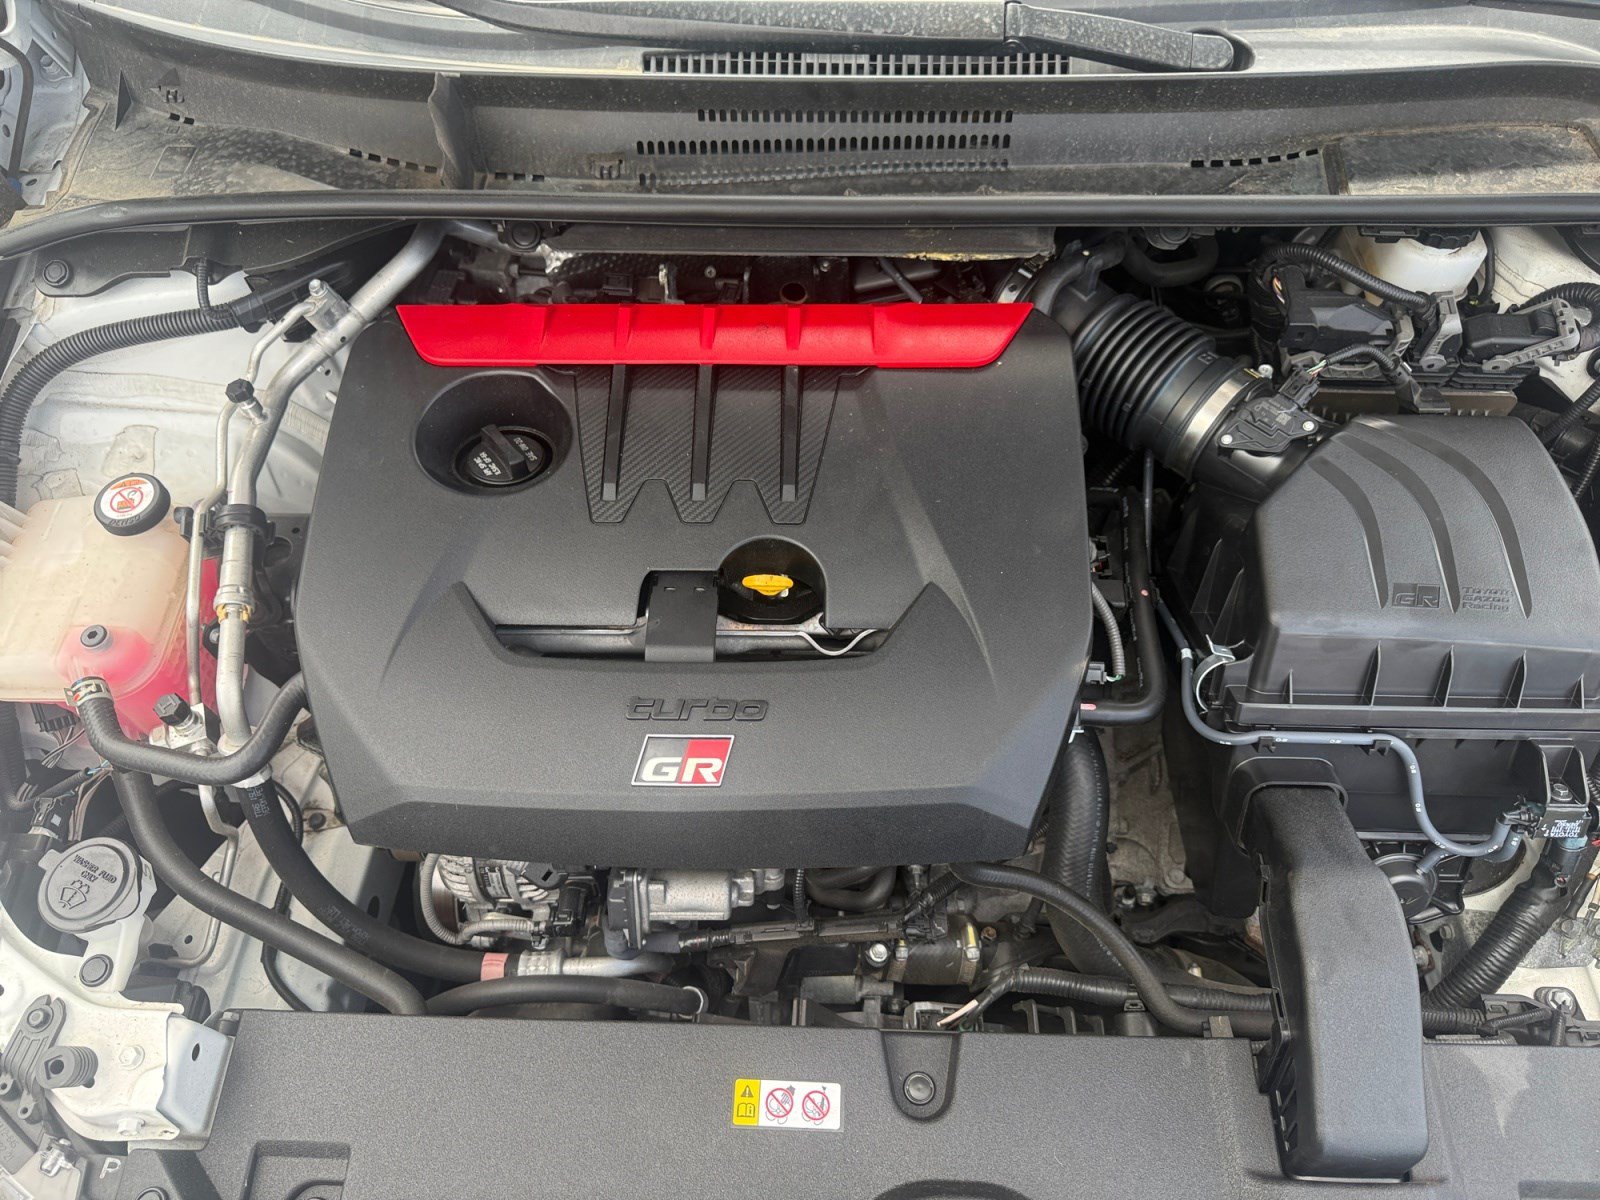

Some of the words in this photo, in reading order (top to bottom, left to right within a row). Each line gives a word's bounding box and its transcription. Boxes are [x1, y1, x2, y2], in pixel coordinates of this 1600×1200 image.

[626, 697, 769, 721] turbo
[641, 756, 723, 783] GR
[73, 854, 99, 874] WASHER
[98, 870, 117, 884] FLUID
[81, 870, 98, 883] ONLY
